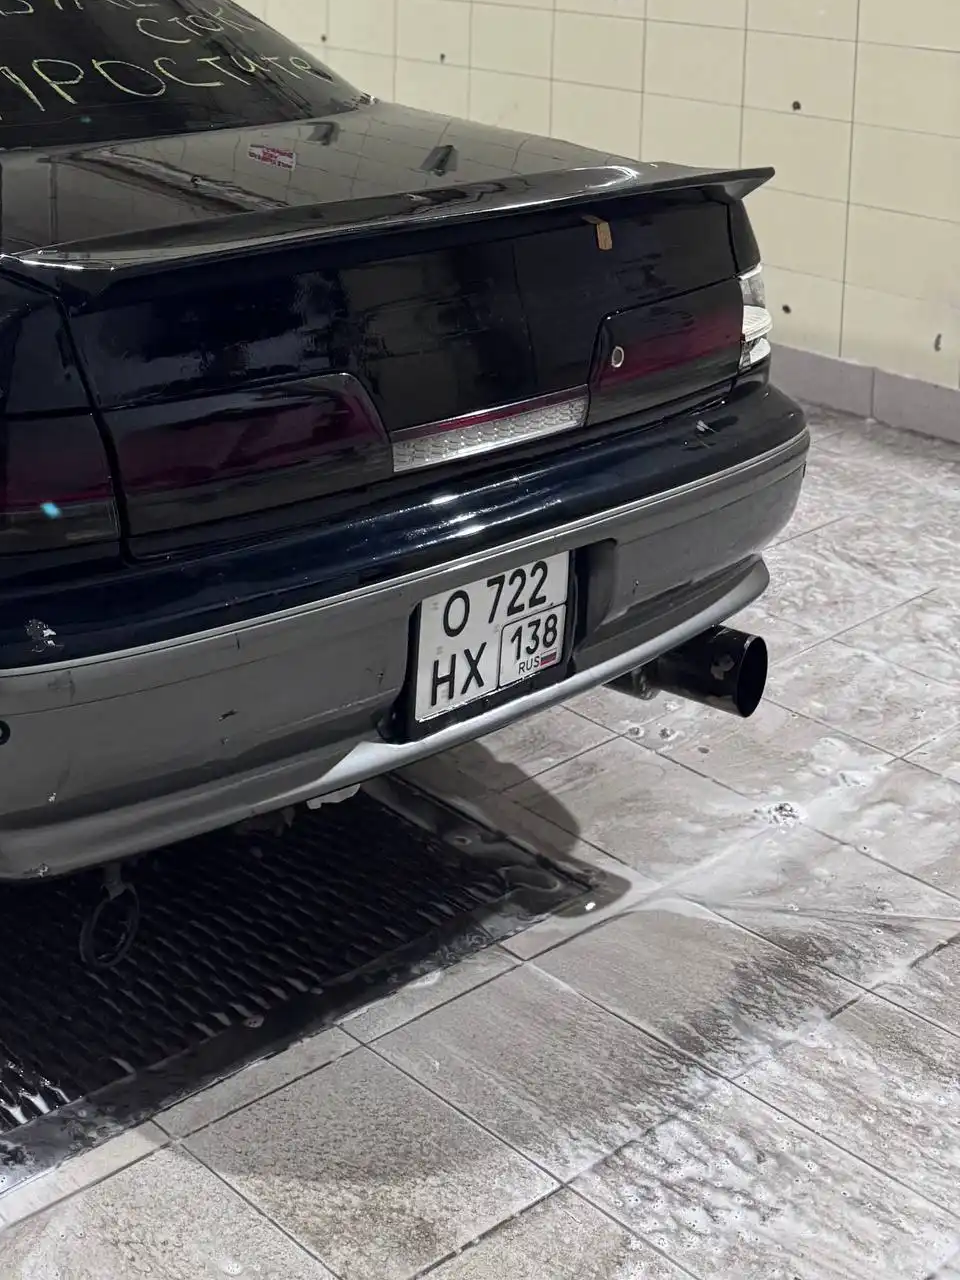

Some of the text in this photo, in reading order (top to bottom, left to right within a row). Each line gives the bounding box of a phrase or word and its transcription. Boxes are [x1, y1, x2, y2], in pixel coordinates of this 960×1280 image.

[487, 561, 548, 624] 722
[511, 614, 557, 660] 138
[518, 656, 540, 674] RUS
